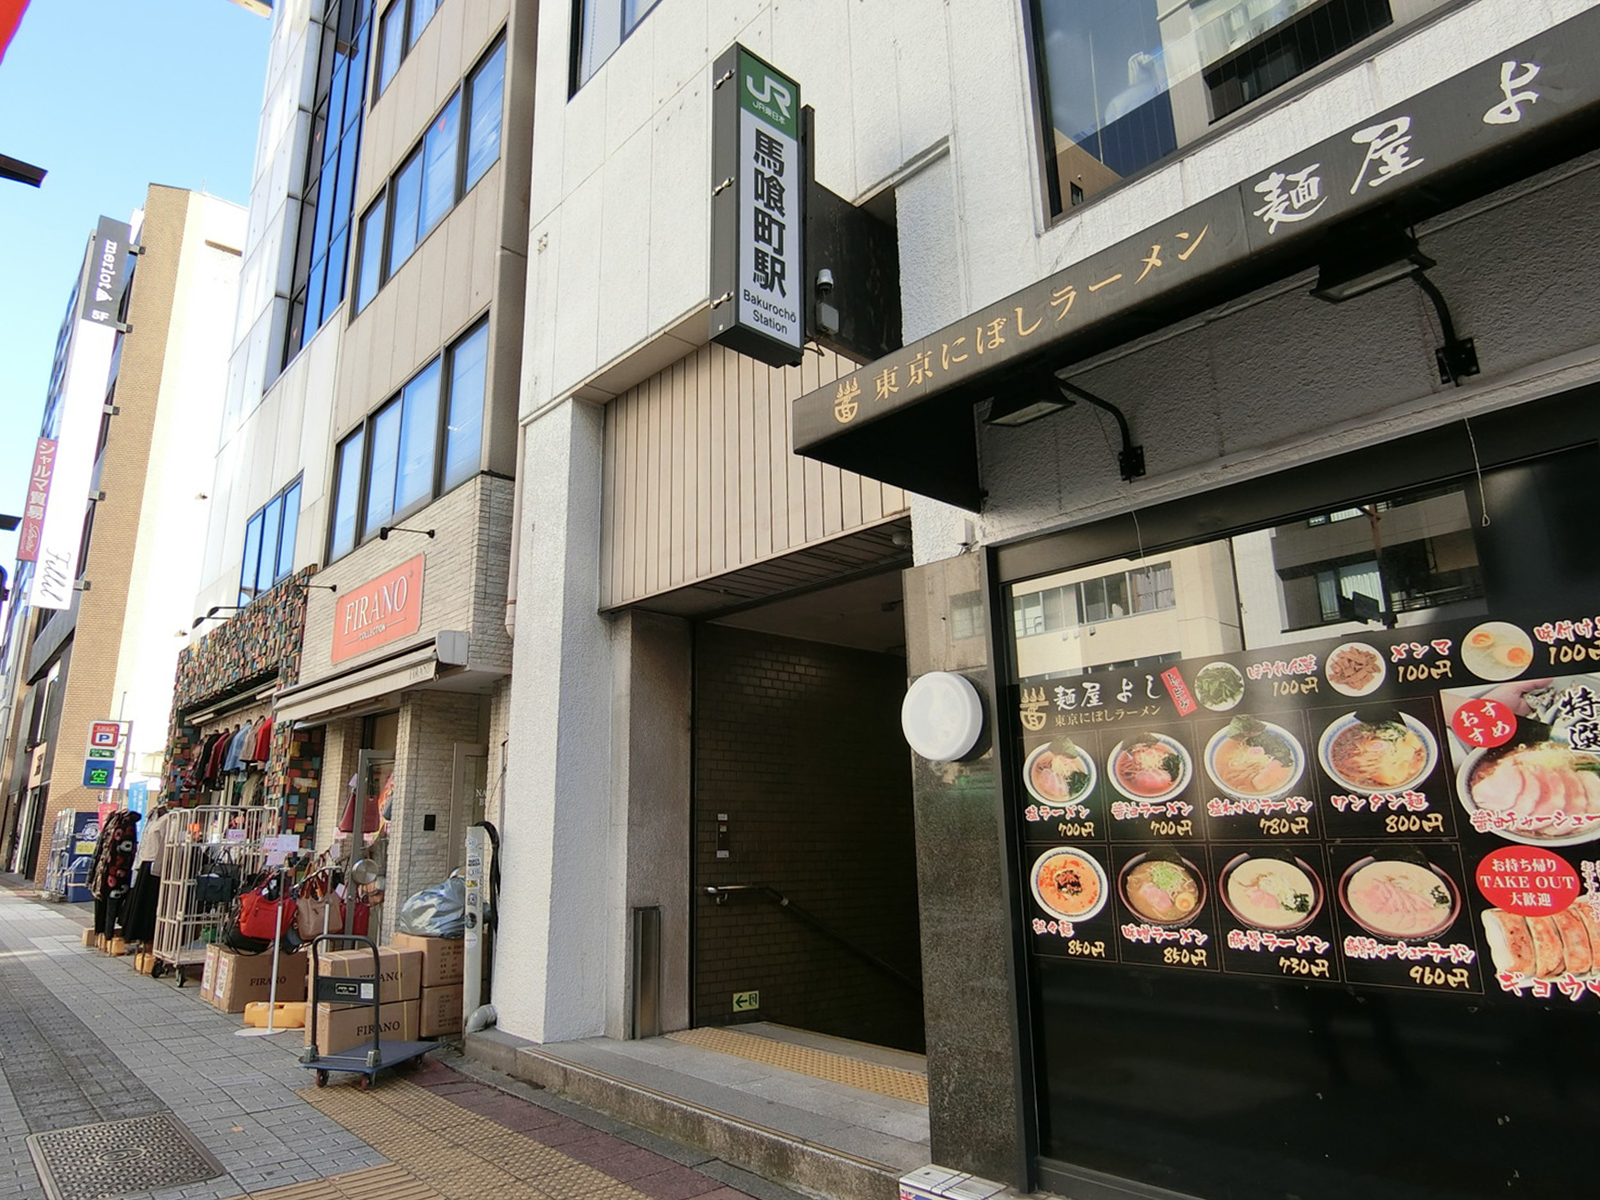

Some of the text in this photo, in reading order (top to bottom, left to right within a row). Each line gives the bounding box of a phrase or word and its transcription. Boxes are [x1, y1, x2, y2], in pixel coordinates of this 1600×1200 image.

[746, 75, 791, 119] JR
[752, 101, 786, 125] JR東日本
[753, 128, 787, 299] 馬喰町駅
[98, 239, 118, 289] merlot
[91, 309, 110, 322] 5F
[743, 288, 797, 323] Bakurochō
[873, 224, 1209, 402] 東京にぼしラーメン
[752, 309, 788, 335] Station
[28, 441, 56, 521] シャルマ貿易
[343, 575, 409, 636] FIRANO
[358, 624, 386, 642] COLLECTION
[1533, 615, 1600, 645] 味付け
[1391, 639, 1452, 663] メンマ
[1246, 654, 1318, 681] ほうれん草
[1397, 659, 1453, 683] 100円
[1272, 676, 1320, 697] 100円
[1054, 704, 1162, 728] 東京にぼしラーメン
[98, 734, 110, 742] P
[90, 769, 108, 784] 空
[1110, 800, 1194, 821] 醤油ラーメン
[1207, 797, 1314, 817] 塩わかめラーメン
[1330, 790, 1429, 812] ワンタン麺
[1025, 803, 1090, 822] 塩ラーメン
[1385, 812, 1445, 833] 800円
[1058, 821, 1095, 837] 700円
[1150, 819, 1193, 837] 700円
[1260, 816, 1310, 835] 780円
[1491, 858, 1557, 873] お持ち帰り
[1479, 875, 1575, 890] TAKE OUT
[1509, 892, 1553, 907] 大歓迎
[1120, 923, 1209, 945] 味噌ラーメン
[1227, 928, 1330, 954] 豚骨ラーメン
[1067, 939, 1106, 958] 850円
[1163, 948, 1207, 967] 850円
[1279, 956, 1330, 978] 730円
[1409, 965, 1470, 989] 960円
